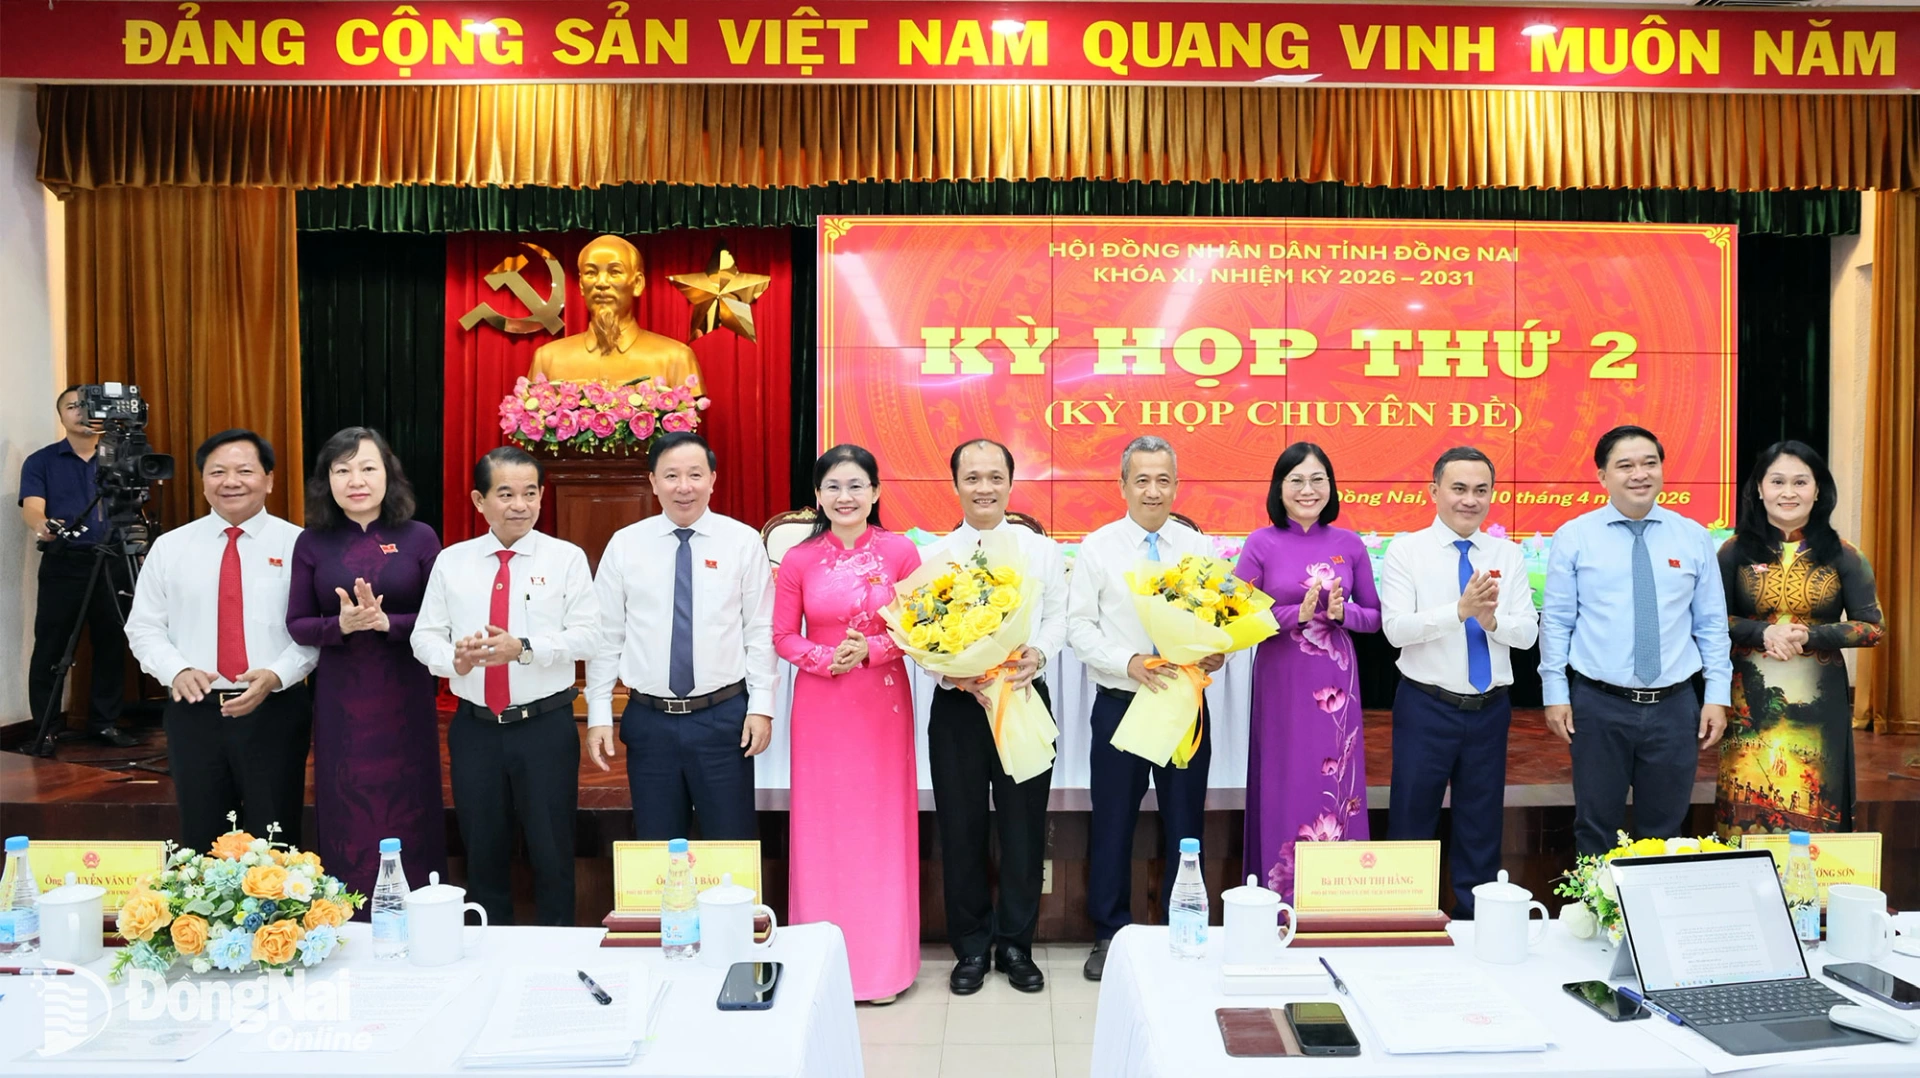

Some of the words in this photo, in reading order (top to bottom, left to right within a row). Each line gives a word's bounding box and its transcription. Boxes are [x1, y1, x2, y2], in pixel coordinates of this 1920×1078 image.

[122, 3, 305, 65] ĐẢNG
[336, 5, 523, 77] CỘNG
[553, 2, 688, 65] SẢN
[718, 7, 869, 76] VIỆT
[899, 20, 1048, 66] NAM
[1083, 21, 1309, 75] QUANG
[1340, 25, 1495, 72] VINH
[1530, 15, 1720, 75] MUÔN
[1754, 19, 1896, 76] NĂM
[1049, 239, 1095, 261] HỘI
[1101, 238, 1180, 258] ĐỒNG
[1187, 240, 1262, 259] NHÂN
[1269, 240, 1321, 260] DÂN
[1327, 240, 1388, 260] TỈNH
[1393, 240, 1471, 262] ĐỒNG
[1477, 246, 1519, 262] NAI
[1093, 264, 1166, 283] KHÓA
[1171, 267, 1203, 285] XI,
[1211, 264, 1294, 287] NHIỆM
[1301, 265, 1334, 284] KỲ
[1339, 269, 1396, 285] 2026
[1419, 270, 1474, 286] 2031
[921, 315, 1060, 375] KỲ
[1093, 327, 1318, 388] HỌP
[1352, 320, 1561, 379] THỨ
[1589, 330, 1638, 379] 2
[1045, 393, 1126, 431] (KỲ
[1139, 400, 1235, 432] HỌP
[1247, 394, 1437, 427] CHUYÊN
[1448, 395, 1523, 433] ĐỀ)
[1386, 490, 1427, 506] Nai,
[1516, 491, 1573, 507] tháng
[1576, 491, 1590, 504] 4
[1655, 491, 1691, 504] 026
[45, 874, 62, 886] Ông
[105, 874, 125, 885] VĂN
[1837, 867, 1855, 877] SƠN
